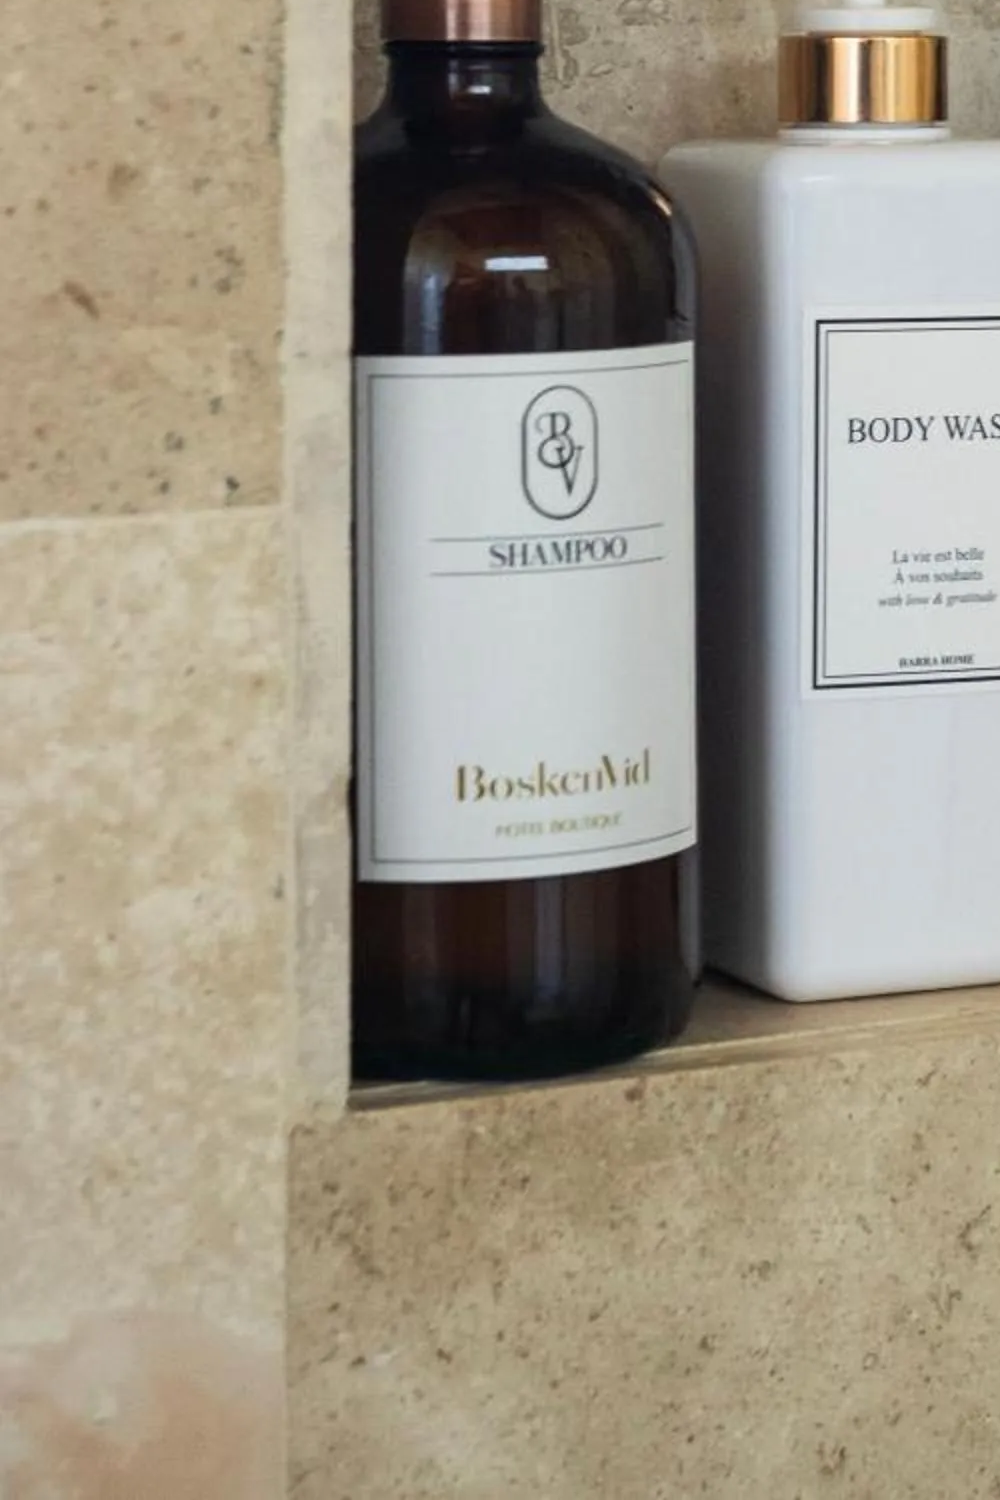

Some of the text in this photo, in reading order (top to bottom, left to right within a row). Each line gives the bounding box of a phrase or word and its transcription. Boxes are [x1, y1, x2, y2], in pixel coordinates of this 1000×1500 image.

[847, 416, 934, 444] BODY
[488, 535, 629, 568] SHAMPOO
[892, 549, 909, 564] La
[913, 553, 932, 563] vie
[934, 550, 952, 562] est
